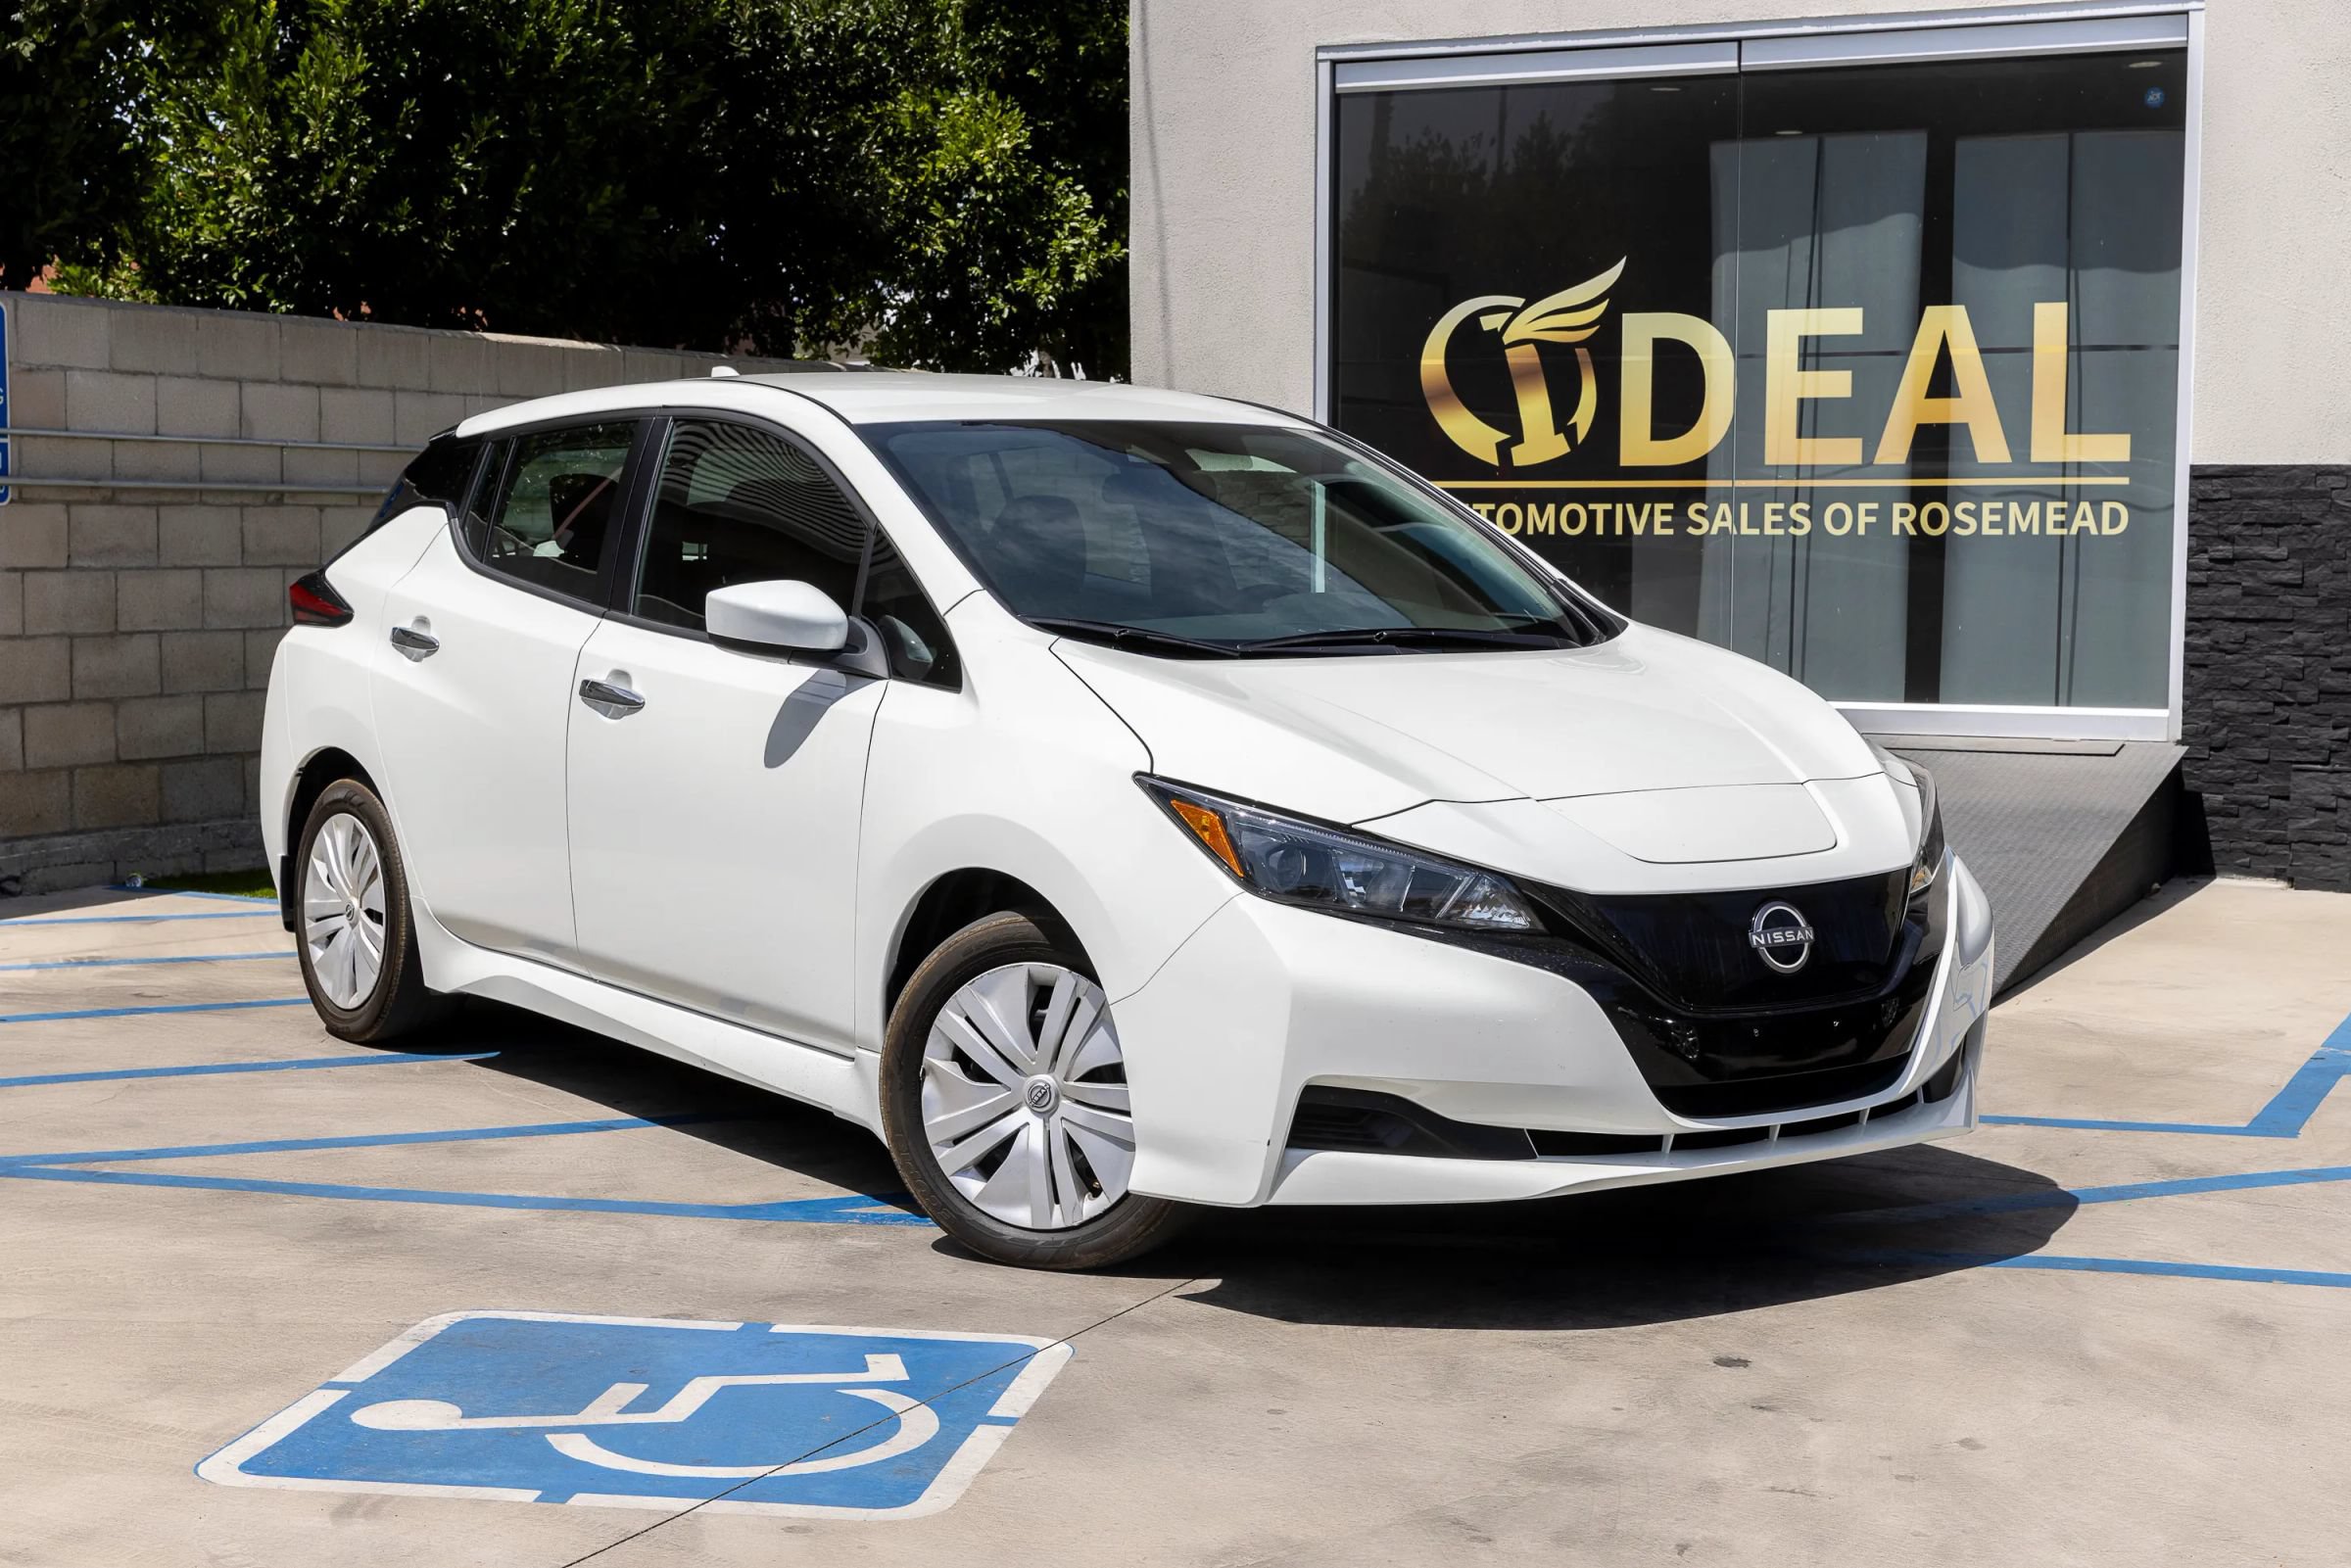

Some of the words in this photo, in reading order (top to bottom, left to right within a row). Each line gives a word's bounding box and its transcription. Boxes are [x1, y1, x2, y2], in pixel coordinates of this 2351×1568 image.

[1465, 502, 1674, 536] TOMOTIVE
[1686, 501, 1812, 536] SALES
[1824, 501, 1879, 536] OF
[1892, 501, 2130, 536] ROSEMEAD
[1751, 929, 1813, 945] NISSAN
